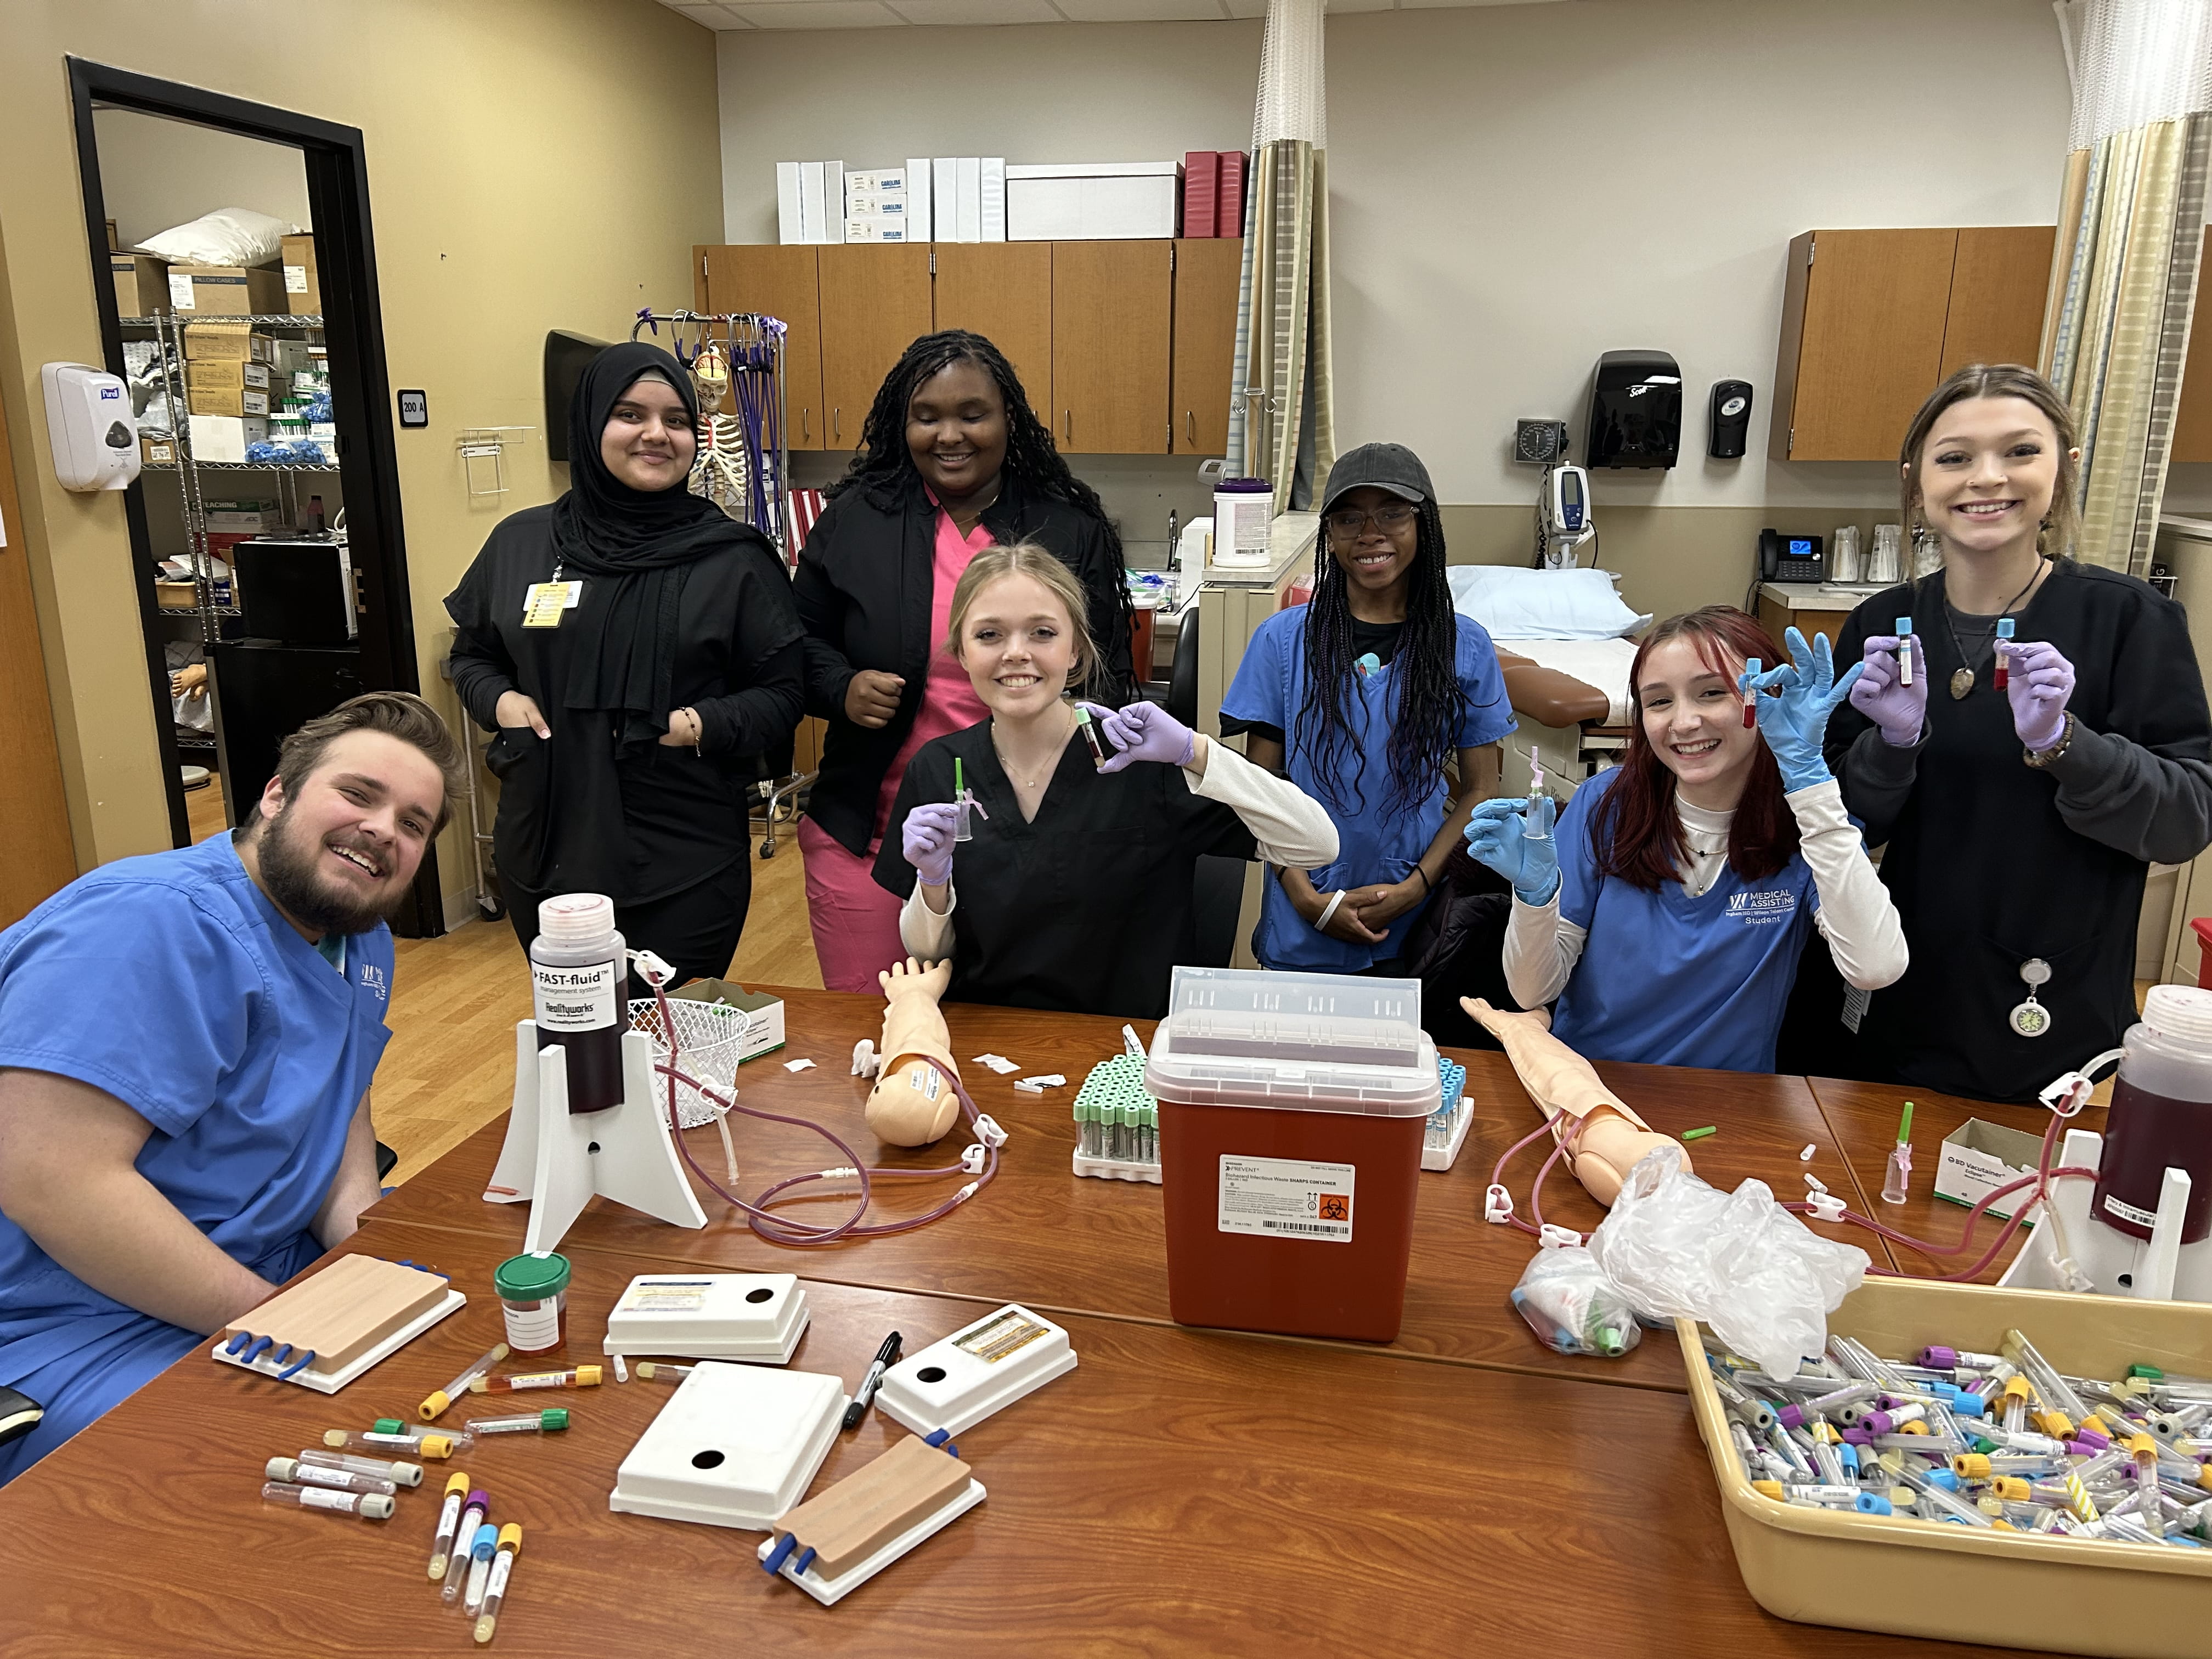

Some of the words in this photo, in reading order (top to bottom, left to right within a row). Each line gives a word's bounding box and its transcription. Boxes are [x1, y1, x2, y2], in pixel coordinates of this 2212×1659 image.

[404, 402, 416, 412] 200
[420, 402, 424, 412] A
[1750, 889, 1791, 900] MEDICAL
[1751, 896, 1795, 908] ASSISTING
[1745, 916, 1780, 924] Student
[540, 986, 577, 995] management
[546, 1002, 594, 1016] Realityworks
